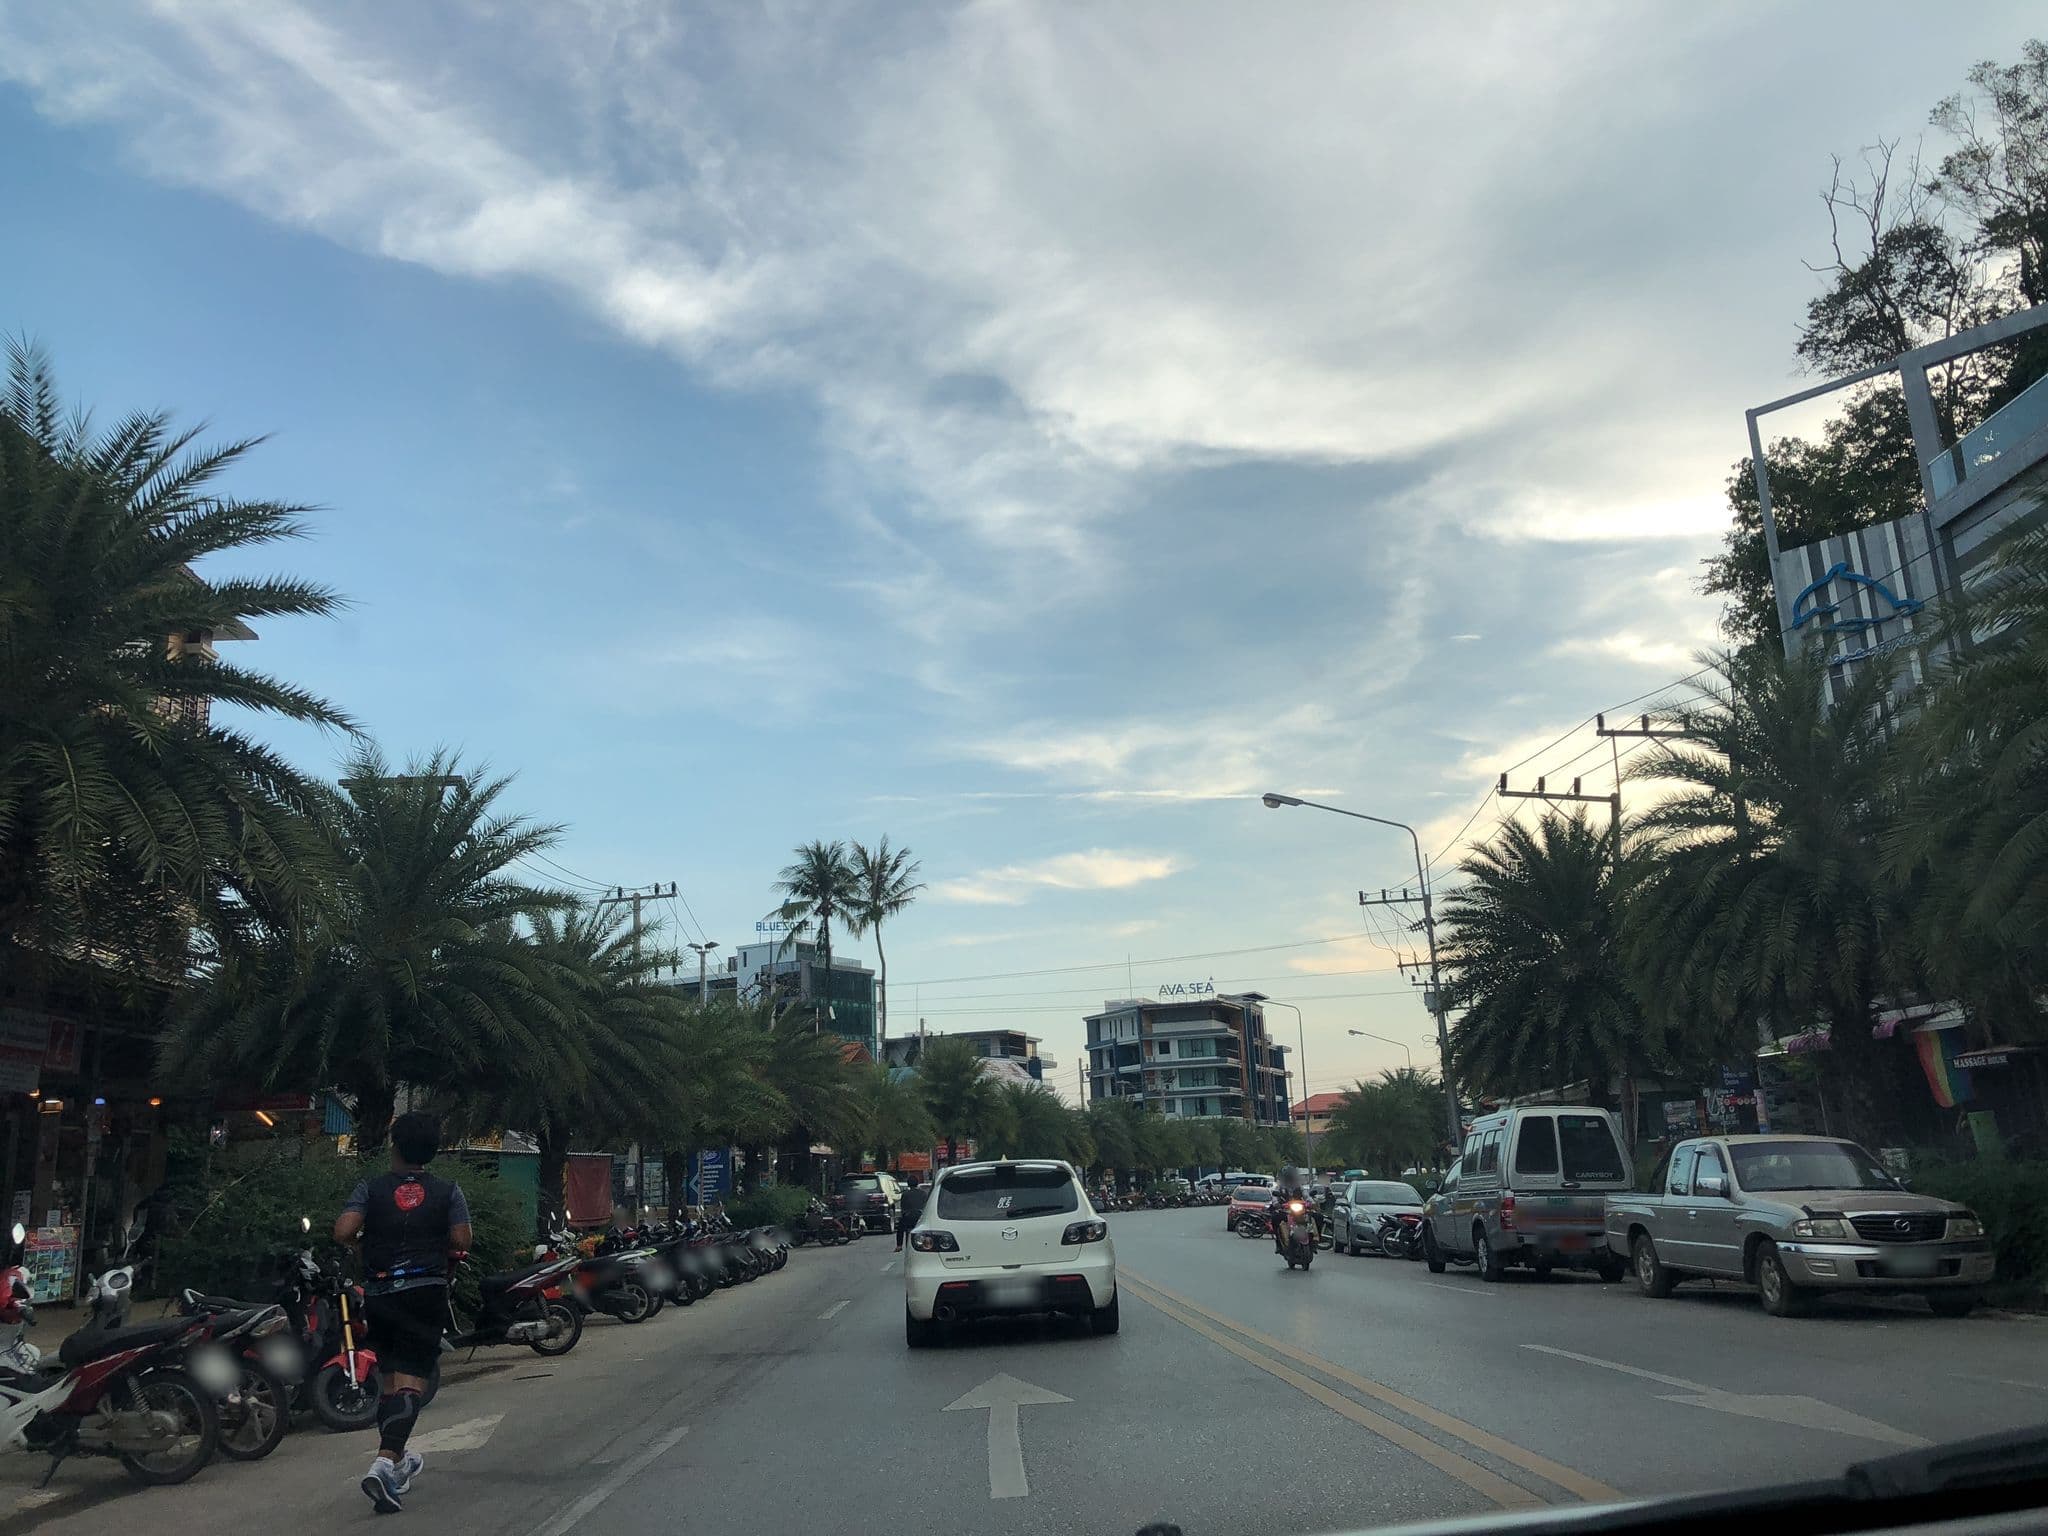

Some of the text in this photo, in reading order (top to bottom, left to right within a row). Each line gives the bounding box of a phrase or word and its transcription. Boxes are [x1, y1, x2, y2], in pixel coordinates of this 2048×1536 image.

[1159, 982, 1215, 996] AVA SEA
[1953, 1055, 2008, 1068] MASSAGE HOUSE
